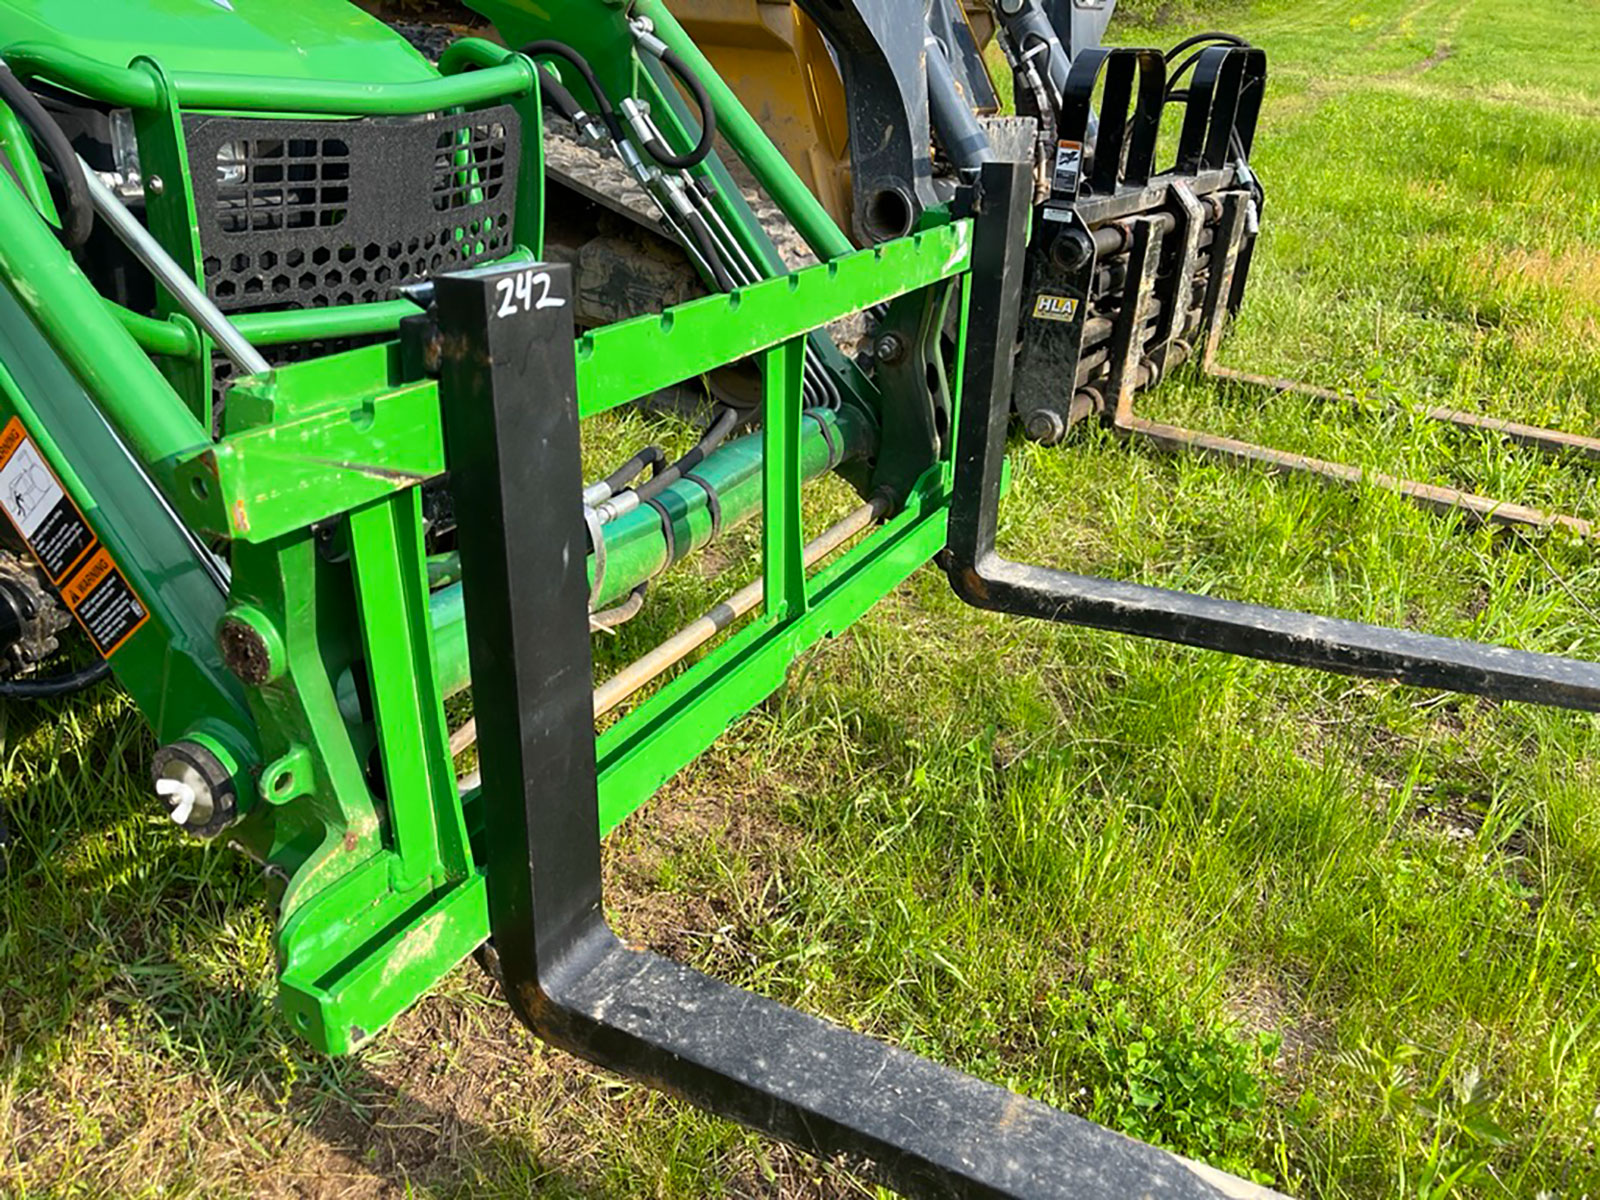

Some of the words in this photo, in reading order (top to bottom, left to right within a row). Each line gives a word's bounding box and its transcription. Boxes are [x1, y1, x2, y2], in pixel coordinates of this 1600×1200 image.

[496, 270, 566, 318] 242
[1038, 297, 1072, 313] HLA
[77, 558, 109, 594] WARNING
